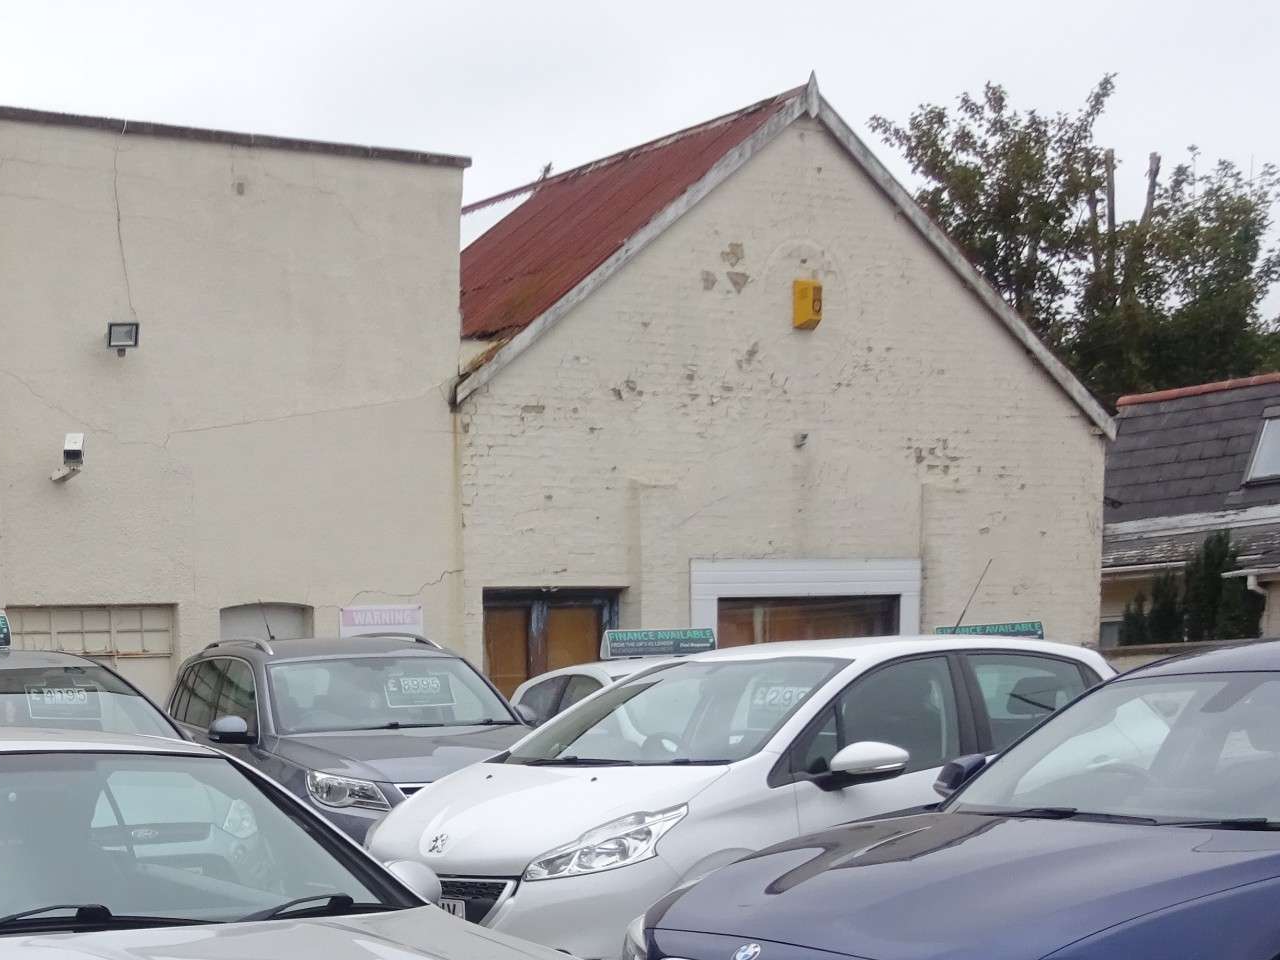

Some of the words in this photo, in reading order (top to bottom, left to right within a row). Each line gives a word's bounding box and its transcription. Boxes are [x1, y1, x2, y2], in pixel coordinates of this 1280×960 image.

[352, 609, 413, 625] WARNING
[609, 632, 657, 641] FINANCE
[657, 630, 712, 640] AVAILABLE
